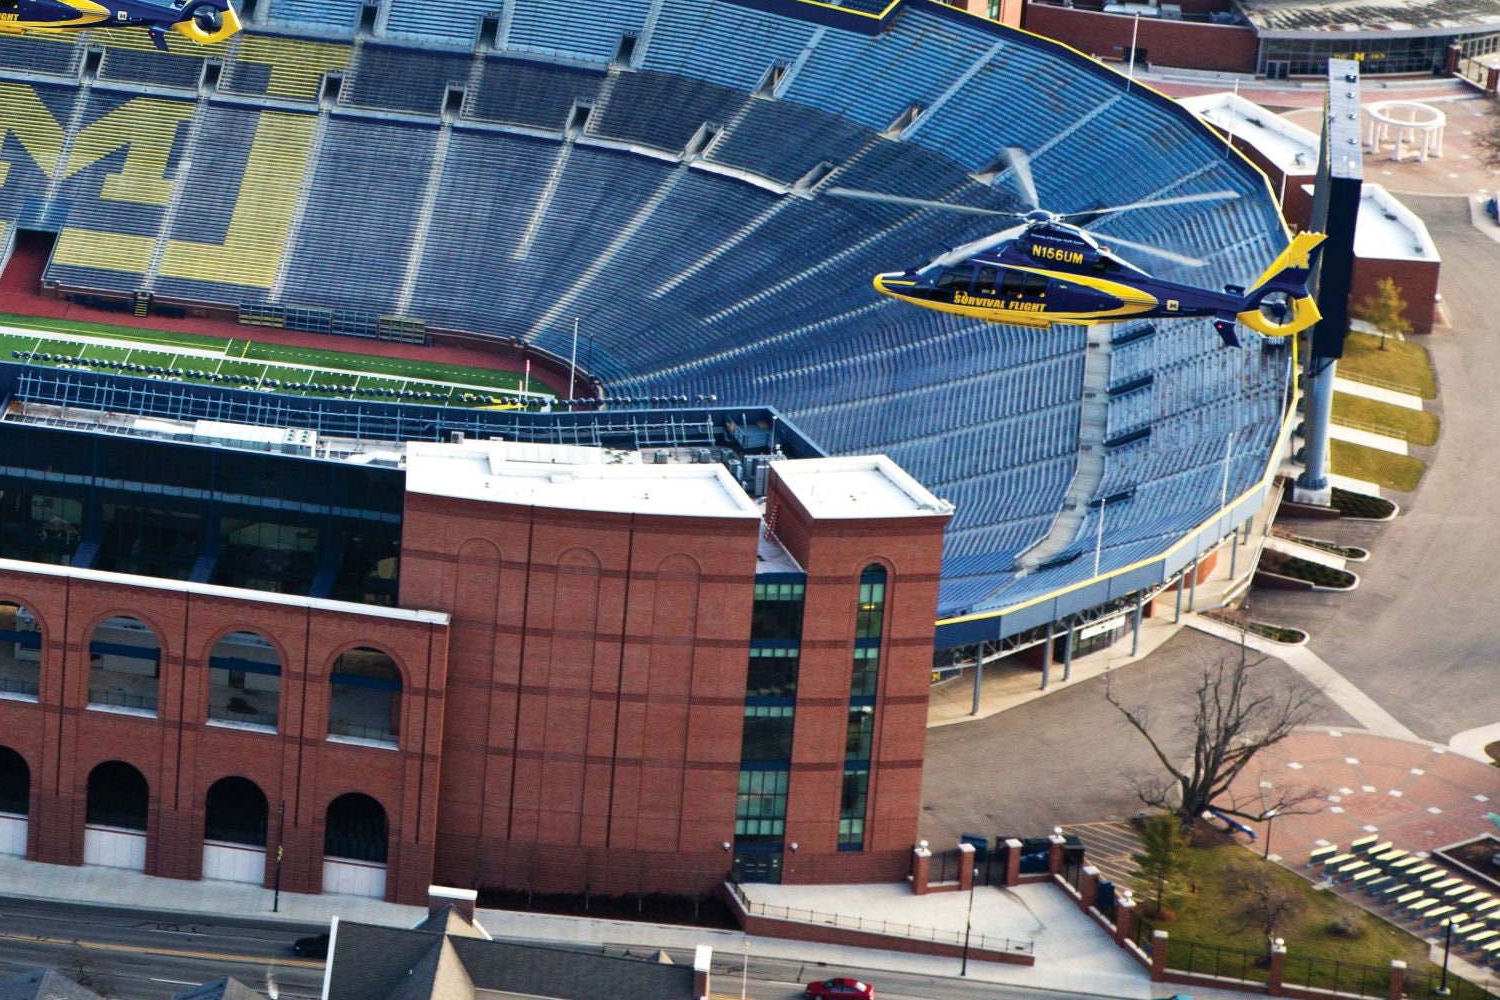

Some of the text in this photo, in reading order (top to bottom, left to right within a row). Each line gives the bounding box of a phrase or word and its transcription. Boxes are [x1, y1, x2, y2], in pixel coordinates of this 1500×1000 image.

[1354, 52, 1365, 61] M
[1032, 244, 1083, 264] N156UM
[953, 294, 1047, 313] SURVIVAL FLIGHT
